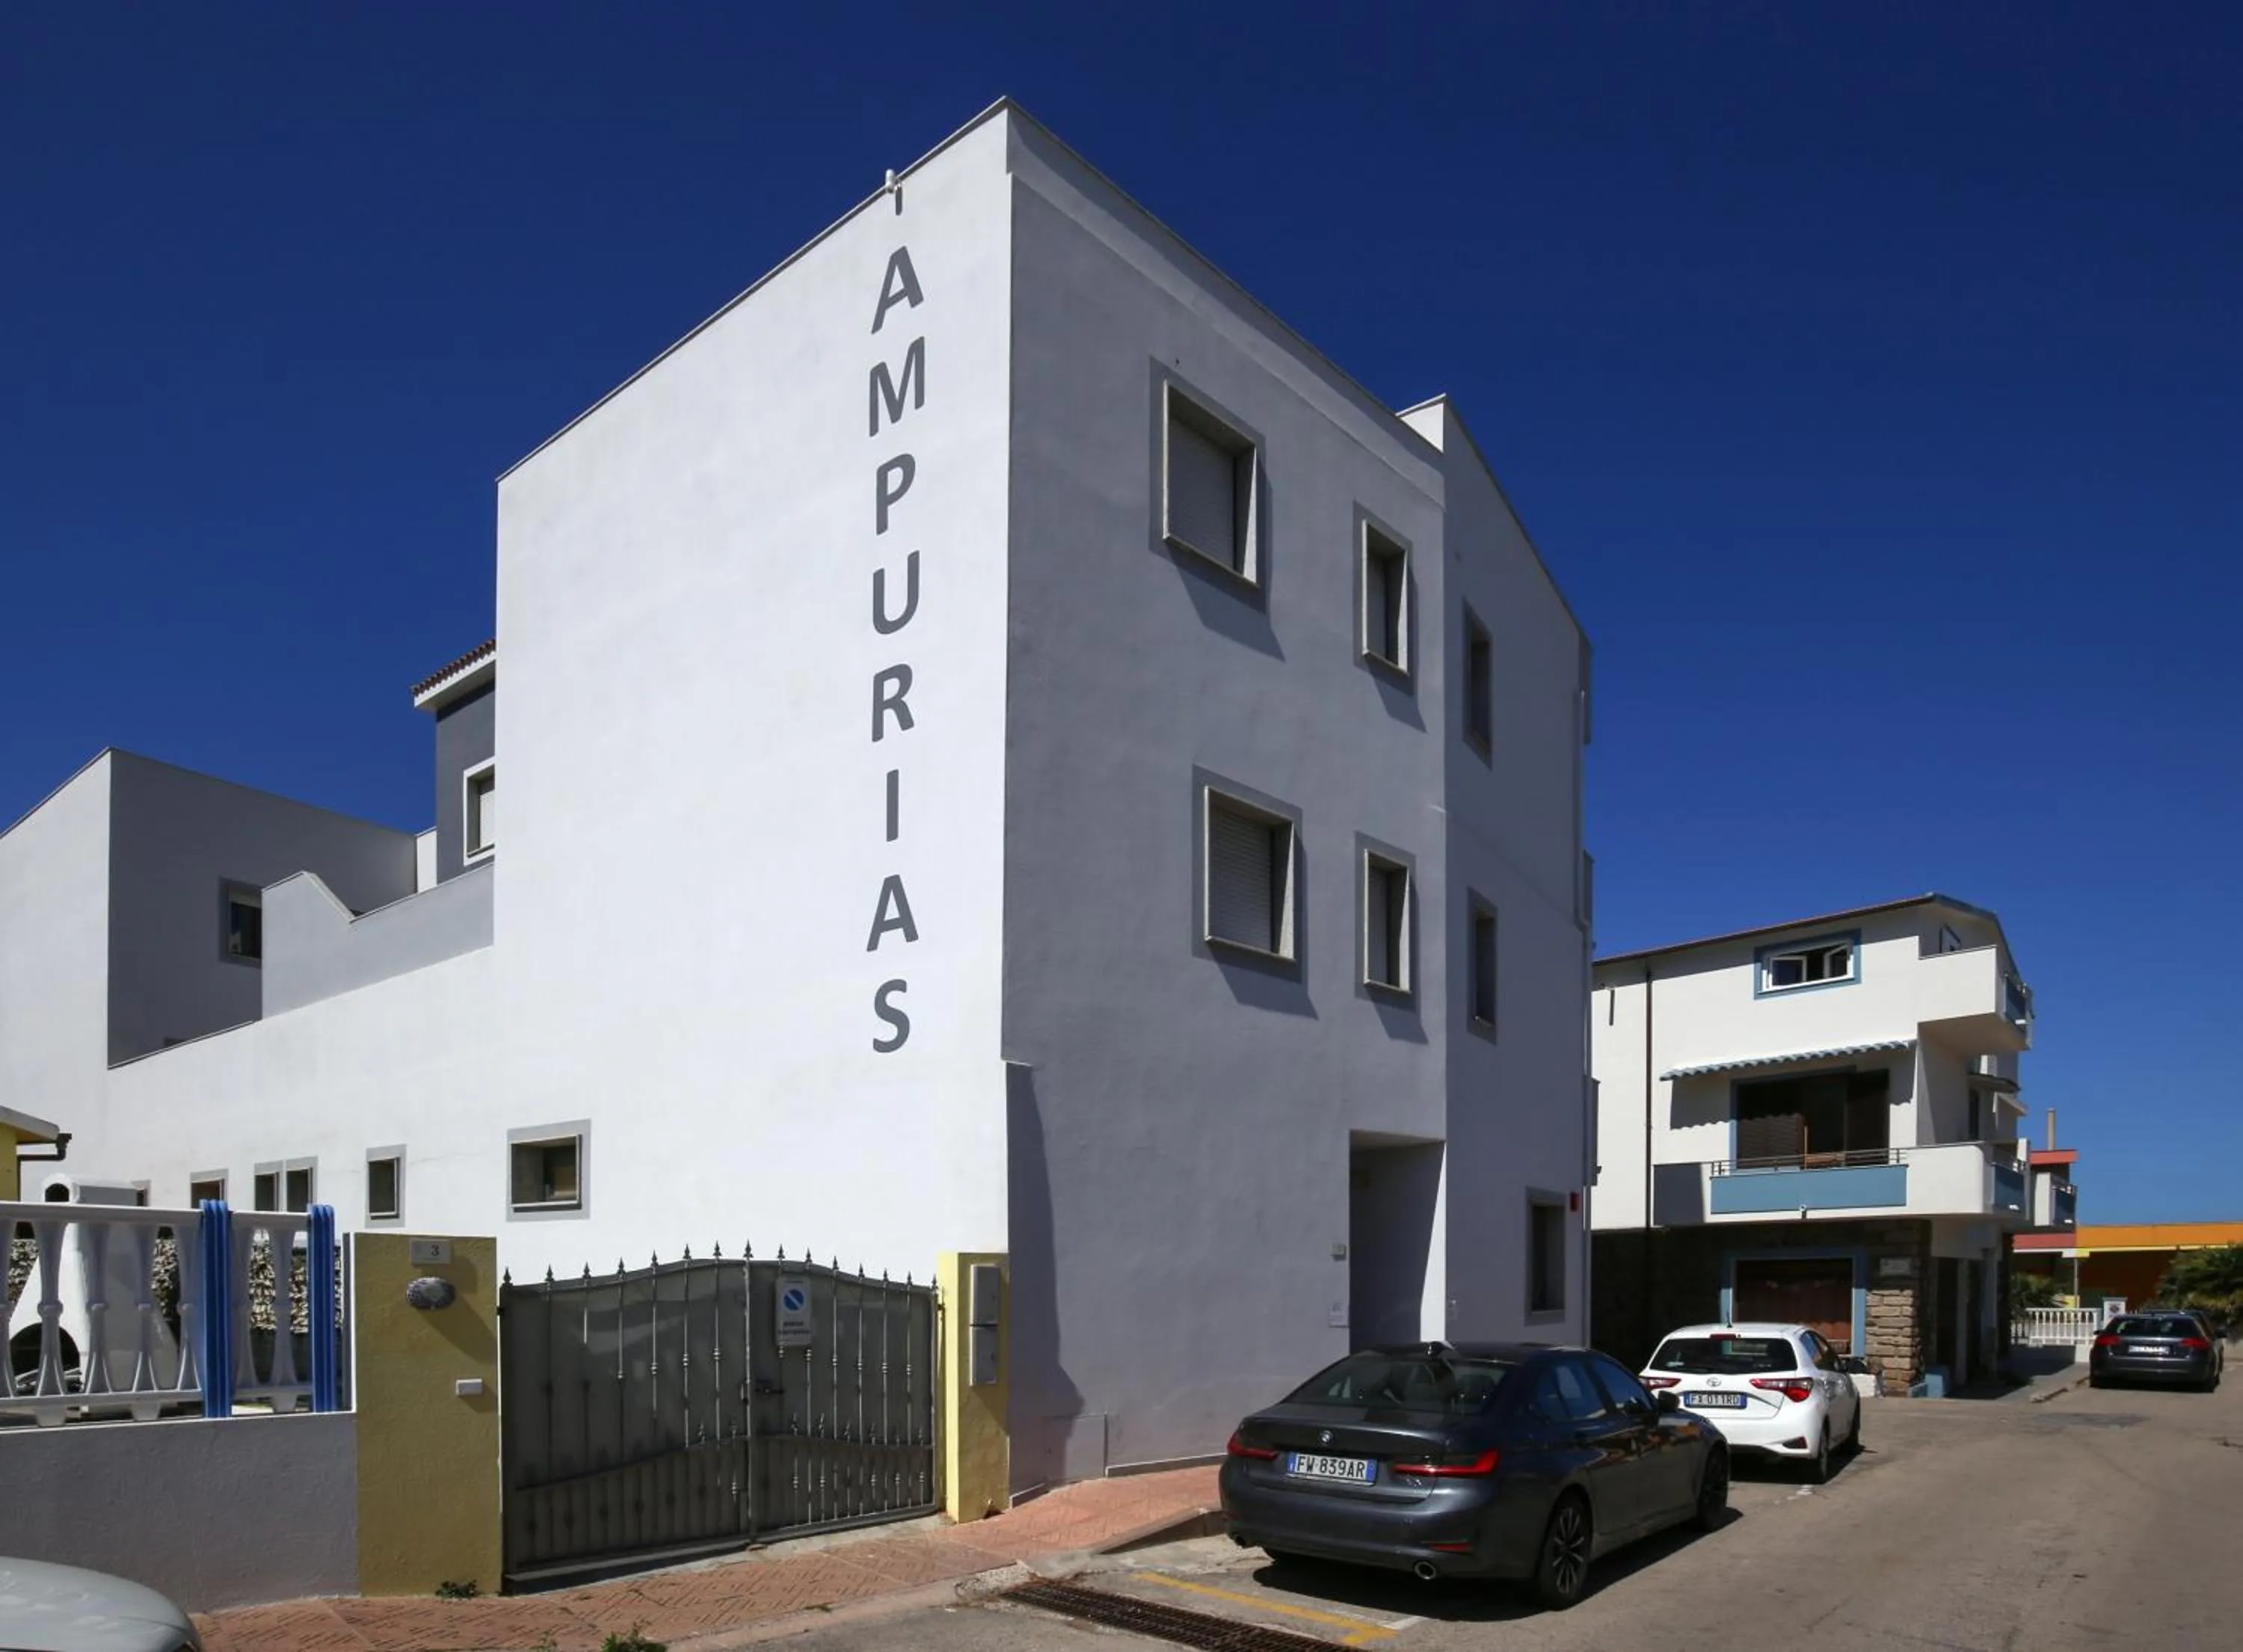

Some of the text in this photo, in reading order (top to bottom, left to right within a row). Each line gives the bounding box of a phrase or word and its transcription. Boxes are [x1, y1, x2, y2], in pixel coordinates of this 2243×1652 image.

[866, 244, 926, 1053] AMPURIAS
[431, 1244, 440, 1257] 3
[1296, 1455, 1366, 1478] FW 839AR
